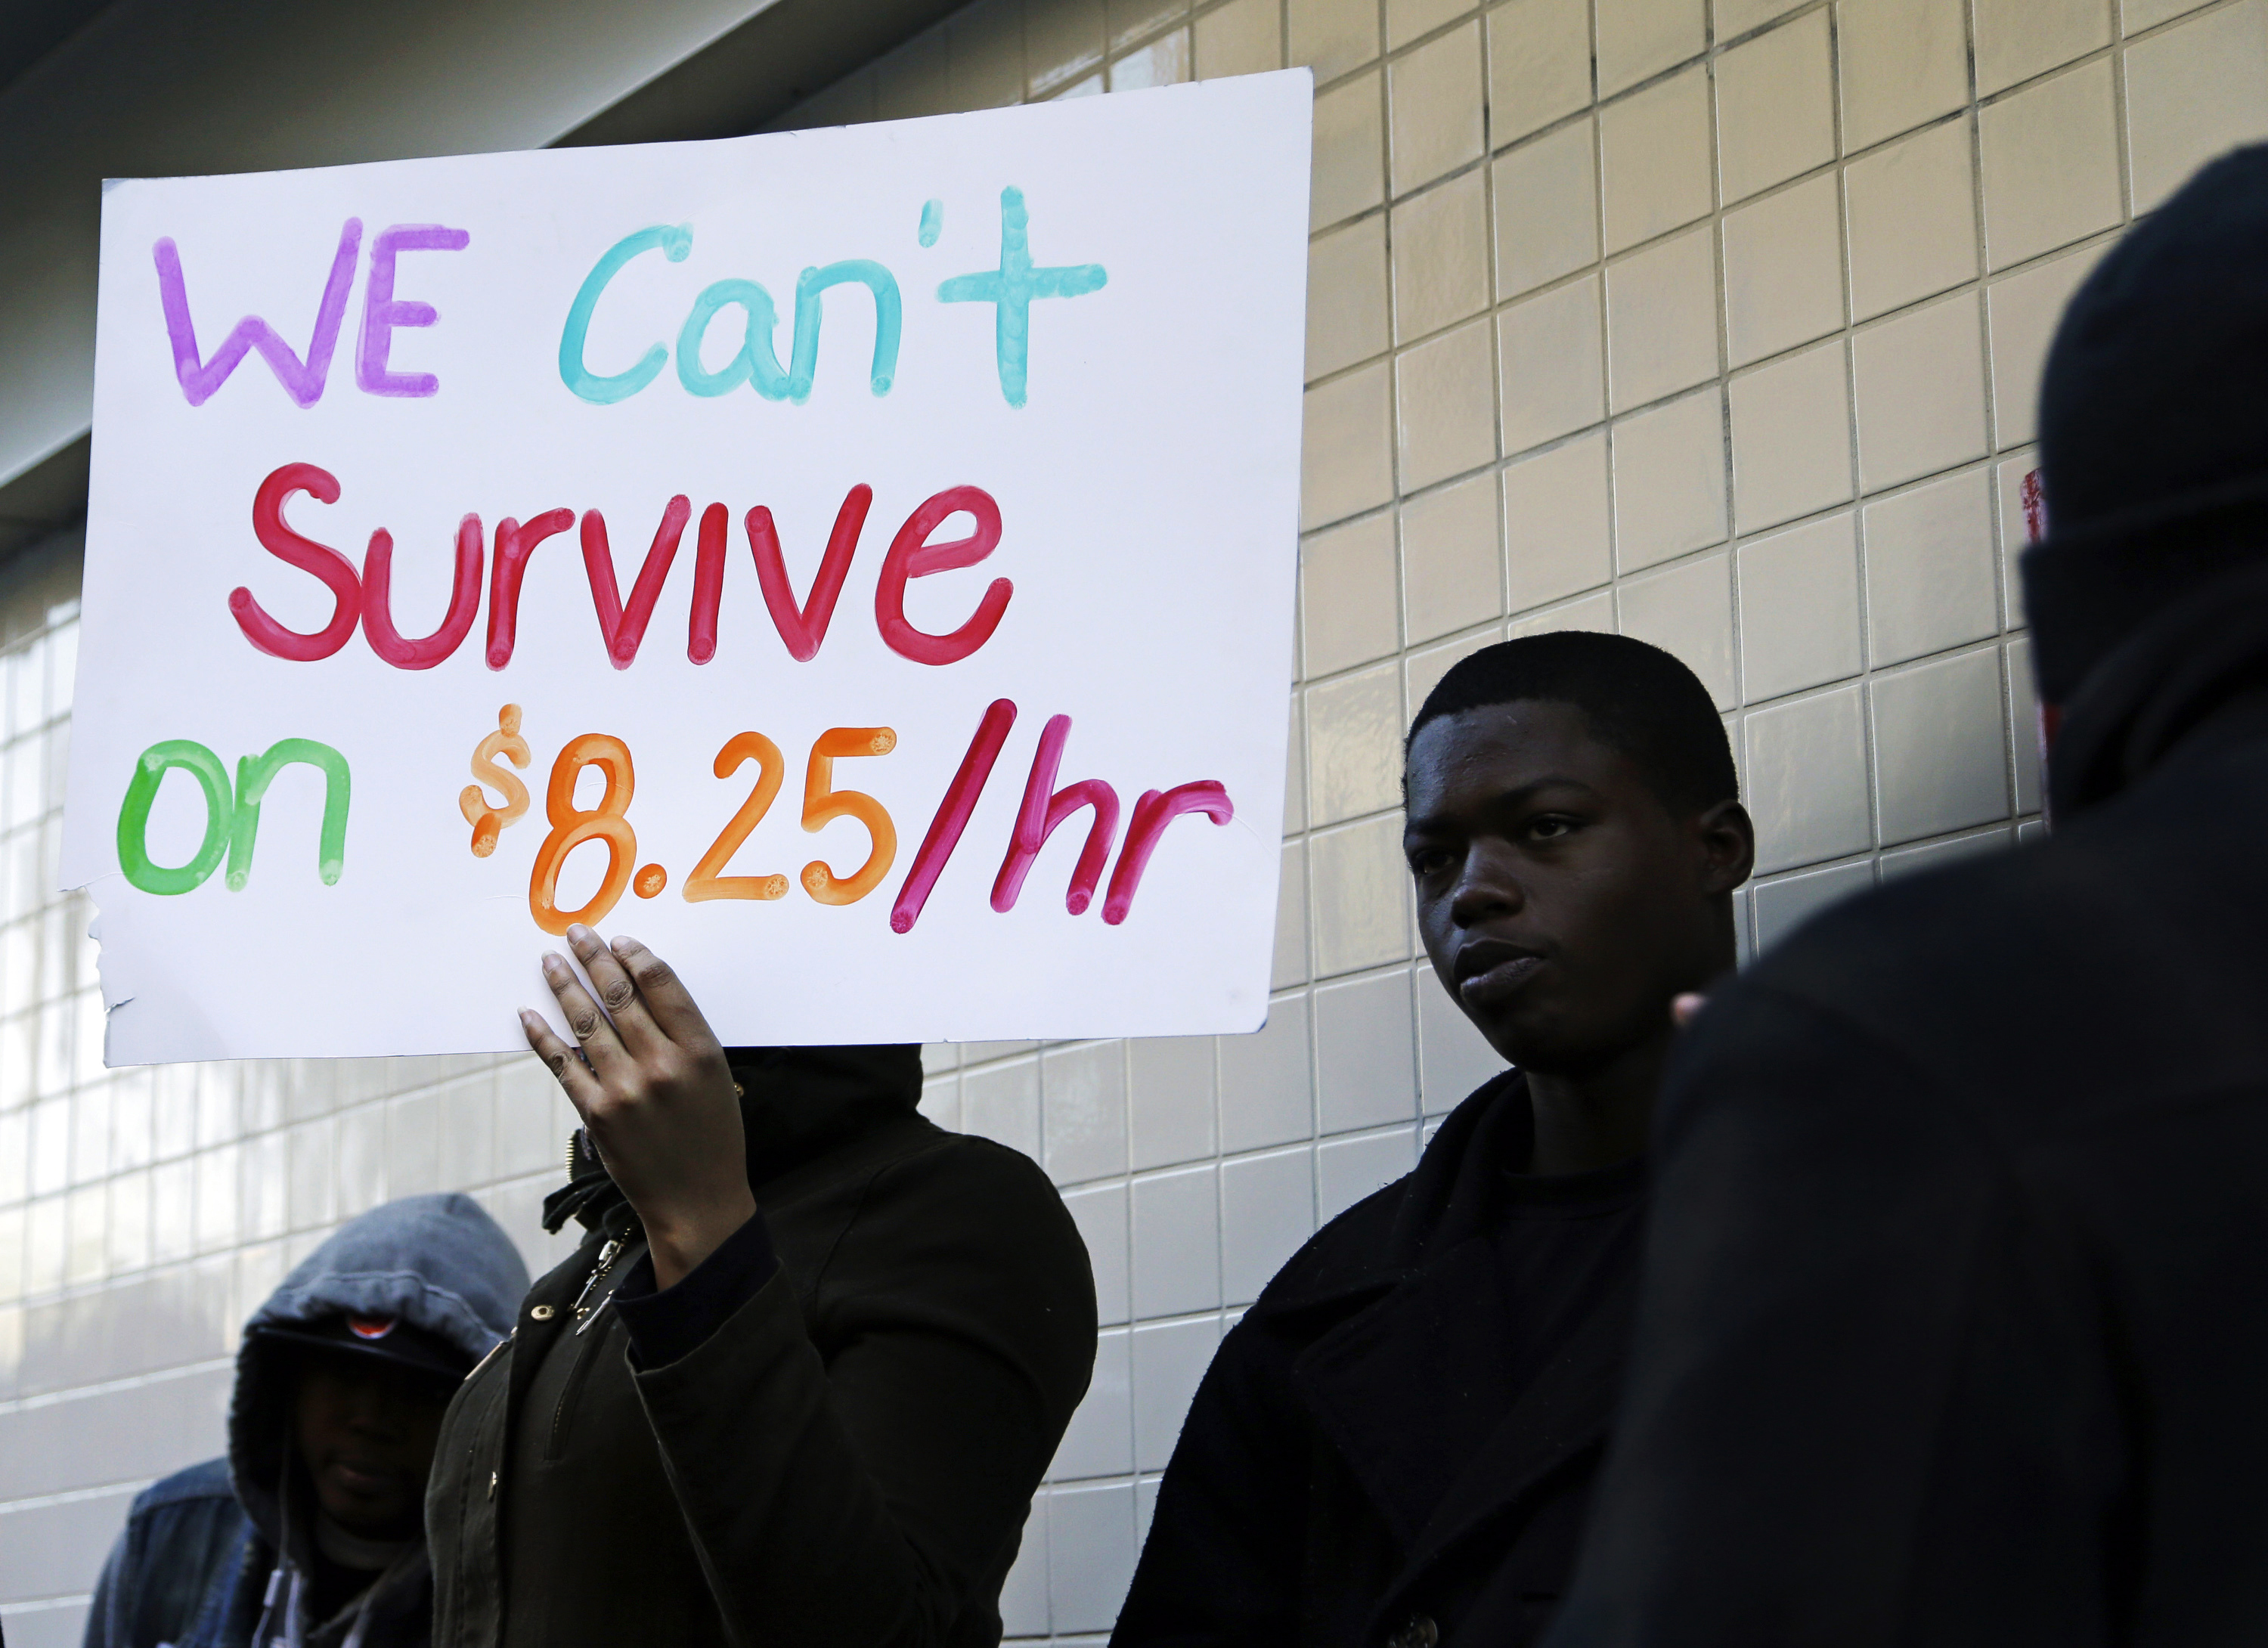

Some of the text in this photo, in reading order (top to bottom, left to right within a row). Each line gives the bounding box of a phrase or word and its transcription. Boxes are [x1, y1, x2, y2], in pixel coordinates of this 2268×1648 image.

[153, 184, 1108, 408] WE Can't
[116, 698, 1234, 936] on $8.25/hr
